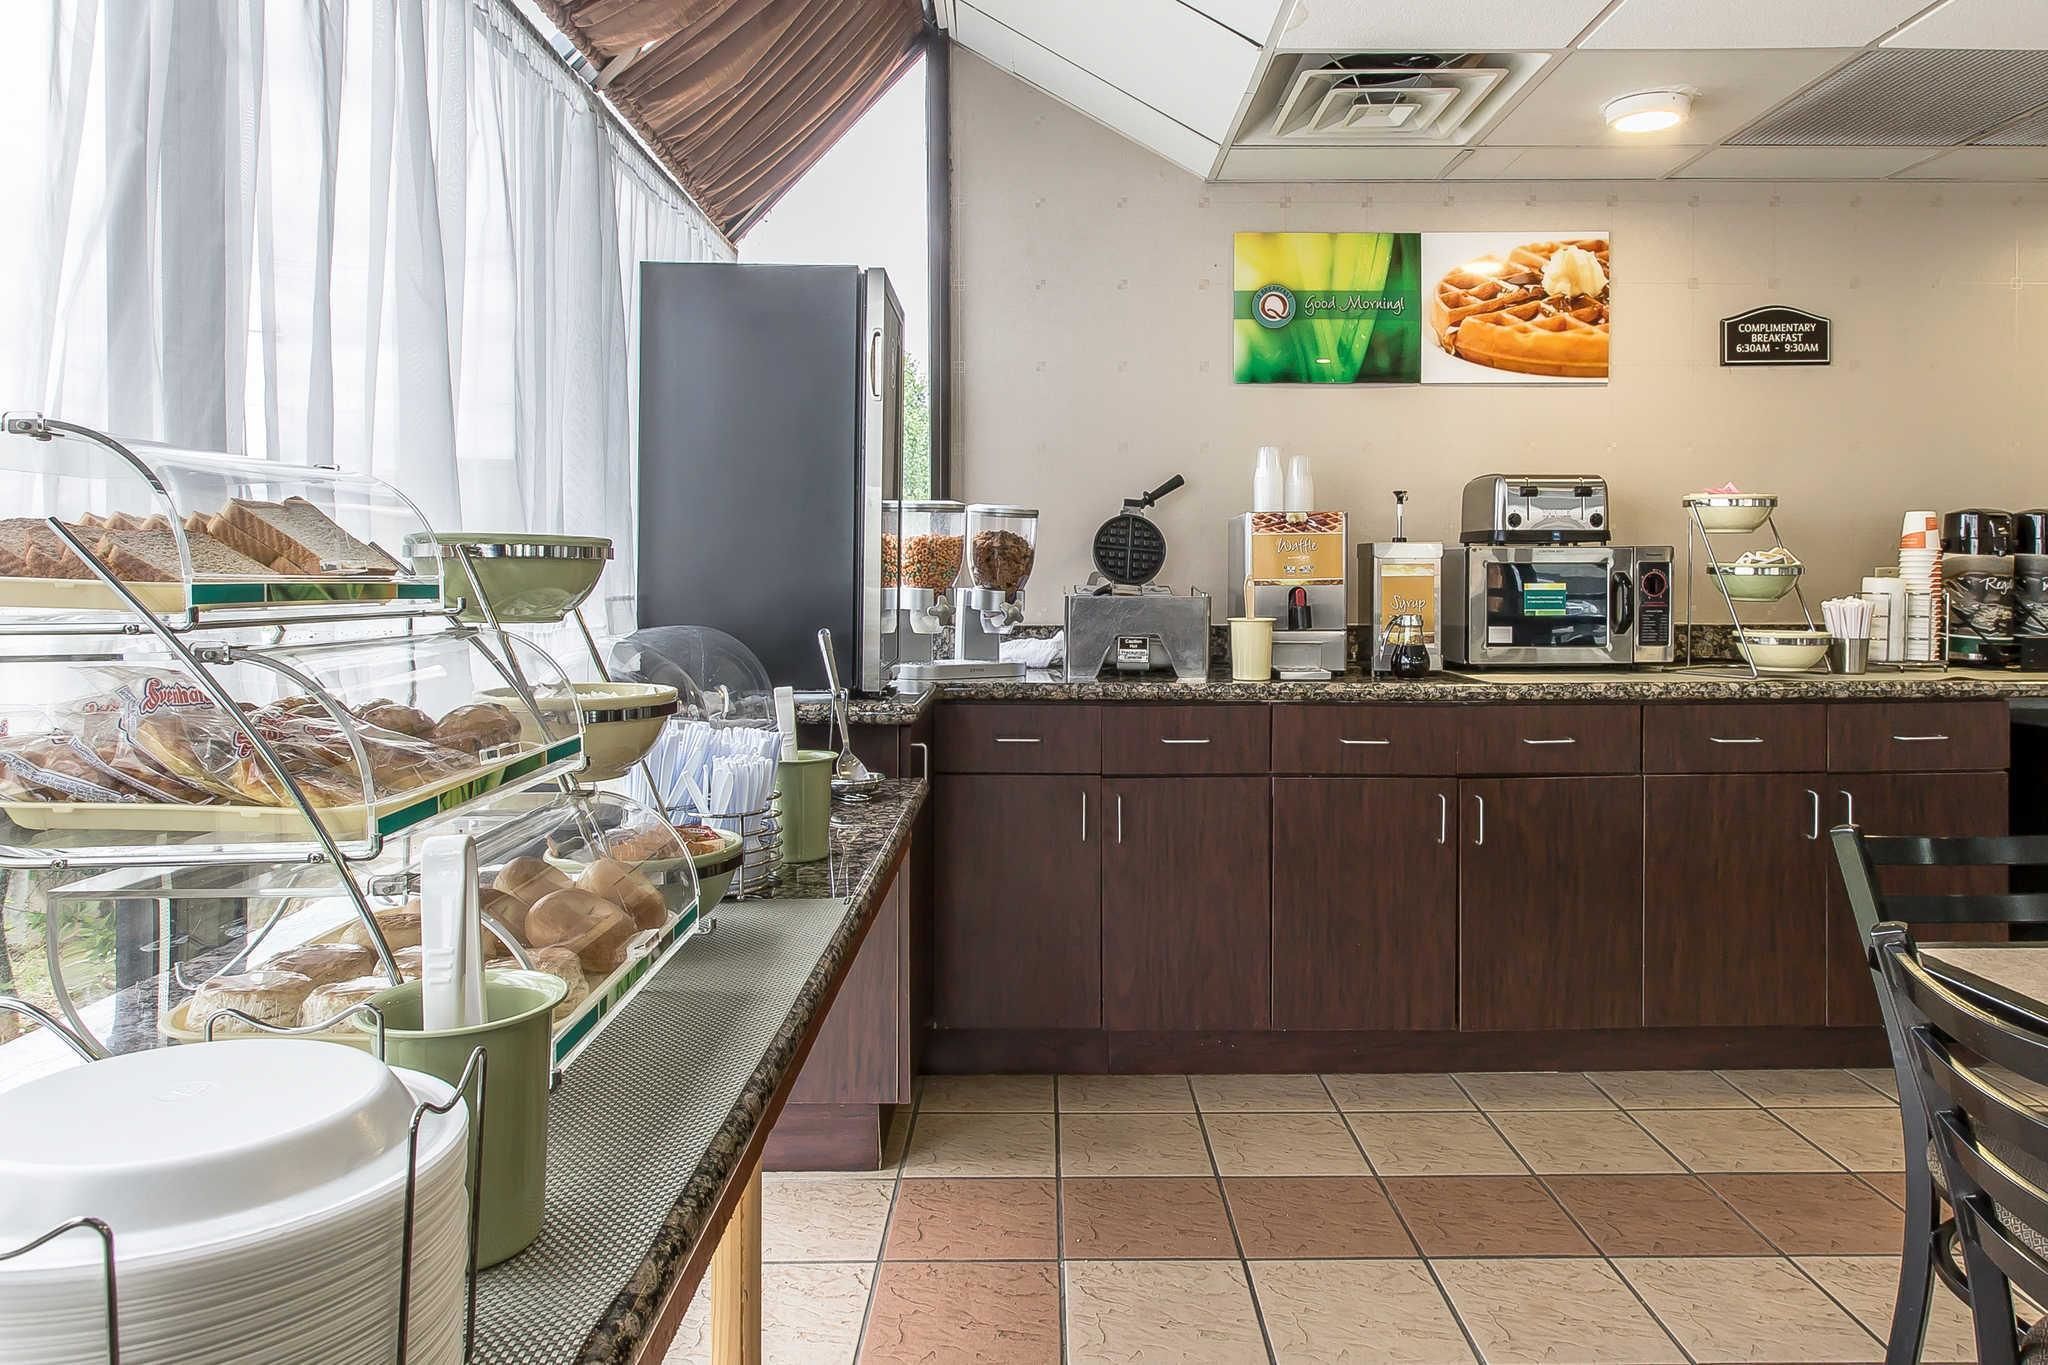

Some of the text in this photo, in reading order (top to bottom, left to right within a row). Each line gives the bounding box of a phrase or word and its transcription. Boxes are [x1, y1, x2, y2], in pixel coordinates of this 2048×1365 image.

[1304, 295, 1405, 317] Good Morning!
[1738, 323, 1817, 333] COMPLIMENTARY
[1751, 333, 1804, 343] BREAKFAST
[1735, 343, 1771, 353] 6:30AM
[1784, 343, 1819, 352] 9:30AM
[1277, 537, 1319, 553] Waffle
[1391, 594, 1426, 613] Syrup
